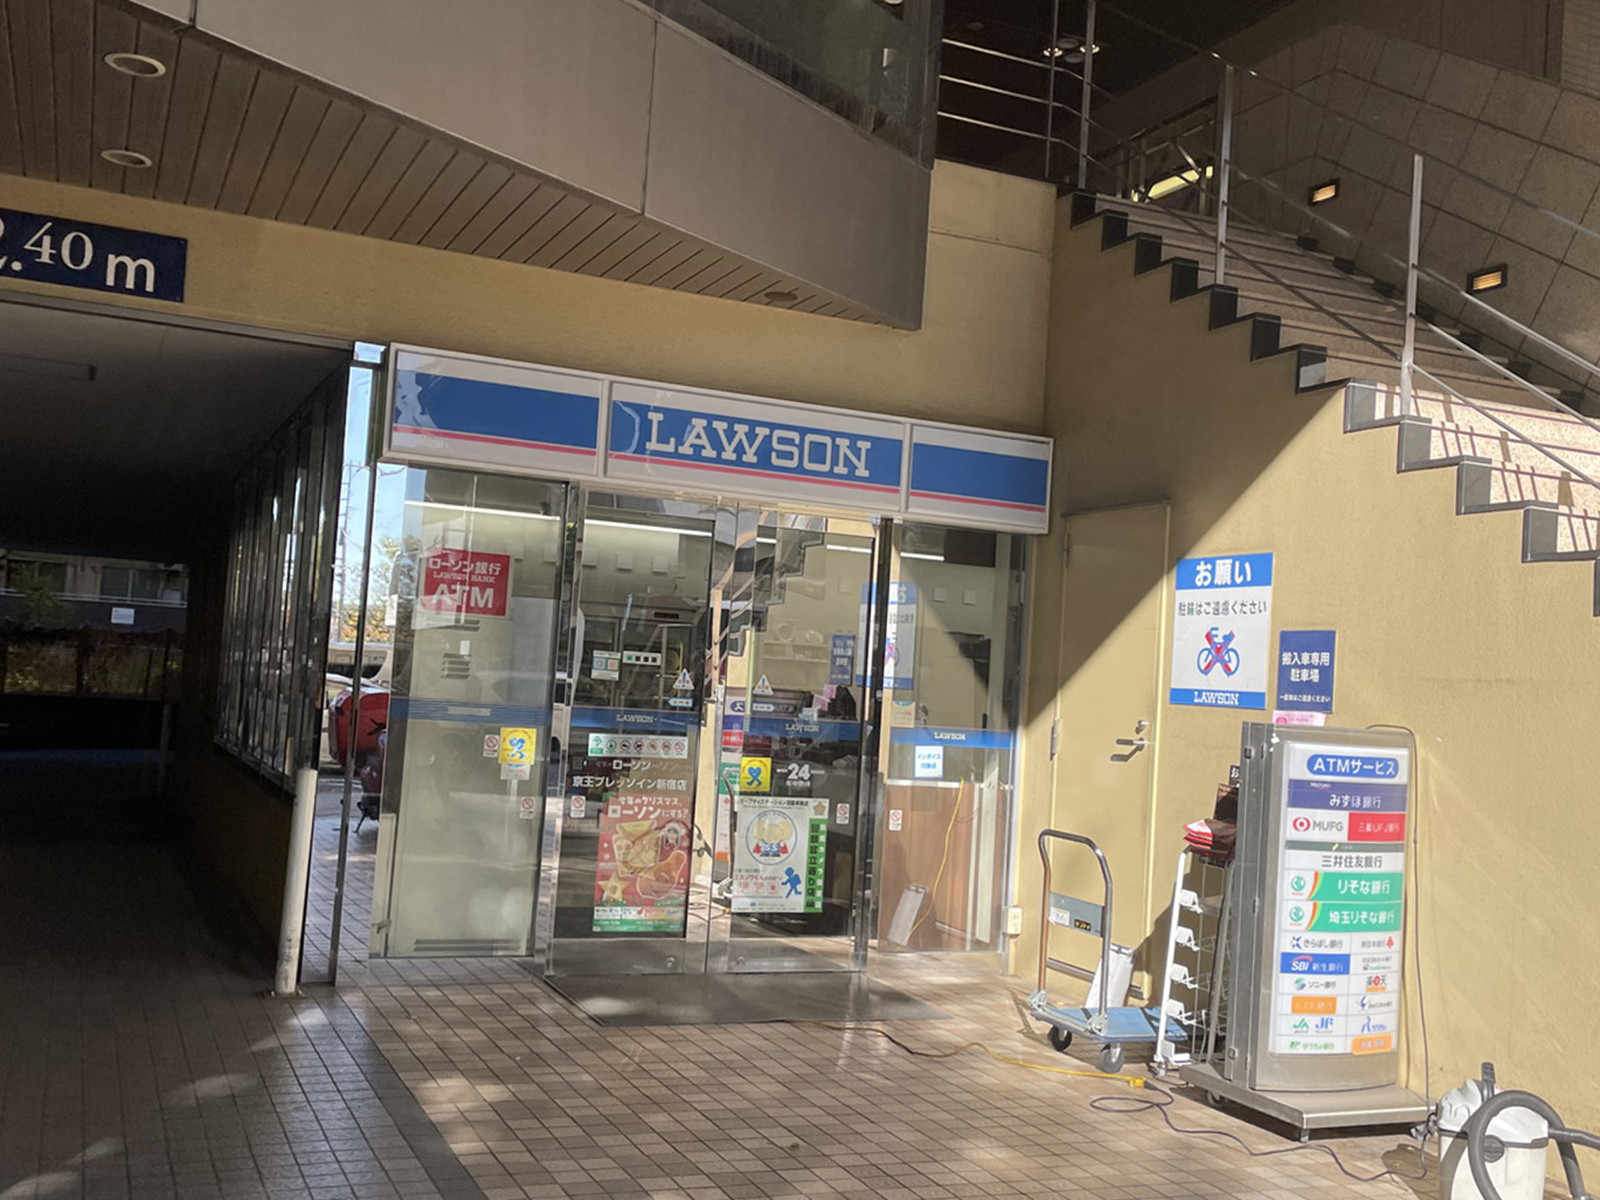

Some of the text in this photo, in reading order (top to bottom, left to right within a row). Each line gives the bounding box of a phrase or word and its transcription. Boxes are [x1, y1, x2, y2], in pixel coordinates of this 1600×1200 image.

[0, 217, 155, 293] .40 m
[645, 411, 872, 477] LAWSON
[429, 557, 502, 576] ローソン銀行
[1195, 558, 1252, 587] お願い
[431, 583, 495, 609] ATM
[1178, 601, 1267, 617] 駐輪はご遠慮ください
[1281, 651, 1330, 666] 搬入車専用
[1290, 668, 1320, 682] 駐車場
[1193, 691, 1239, 705] LAWSON
[616, 713, 655, 724] LAWSON
[785, 723, 820, 733] LAWSON
[934, 731, 966, 741] LAWSON
[612, 759, 652, 771] ローソン
[787, 763, 810, 780] 24
[1313, 757, 1396, 776] ATMサービス
[1329, 793, 1382, 809] みずほ銀行
[1312, 820, 1344, 832] MUFG
[1321, 855, 1382, 869] 三井住友銀行
[1337, 879, 1391, 895] りそな銀行
[1329, 910, 1395, 925] 埼玉りそな銀行
[1303, 939, 1343, 949] きらぼし銀行
